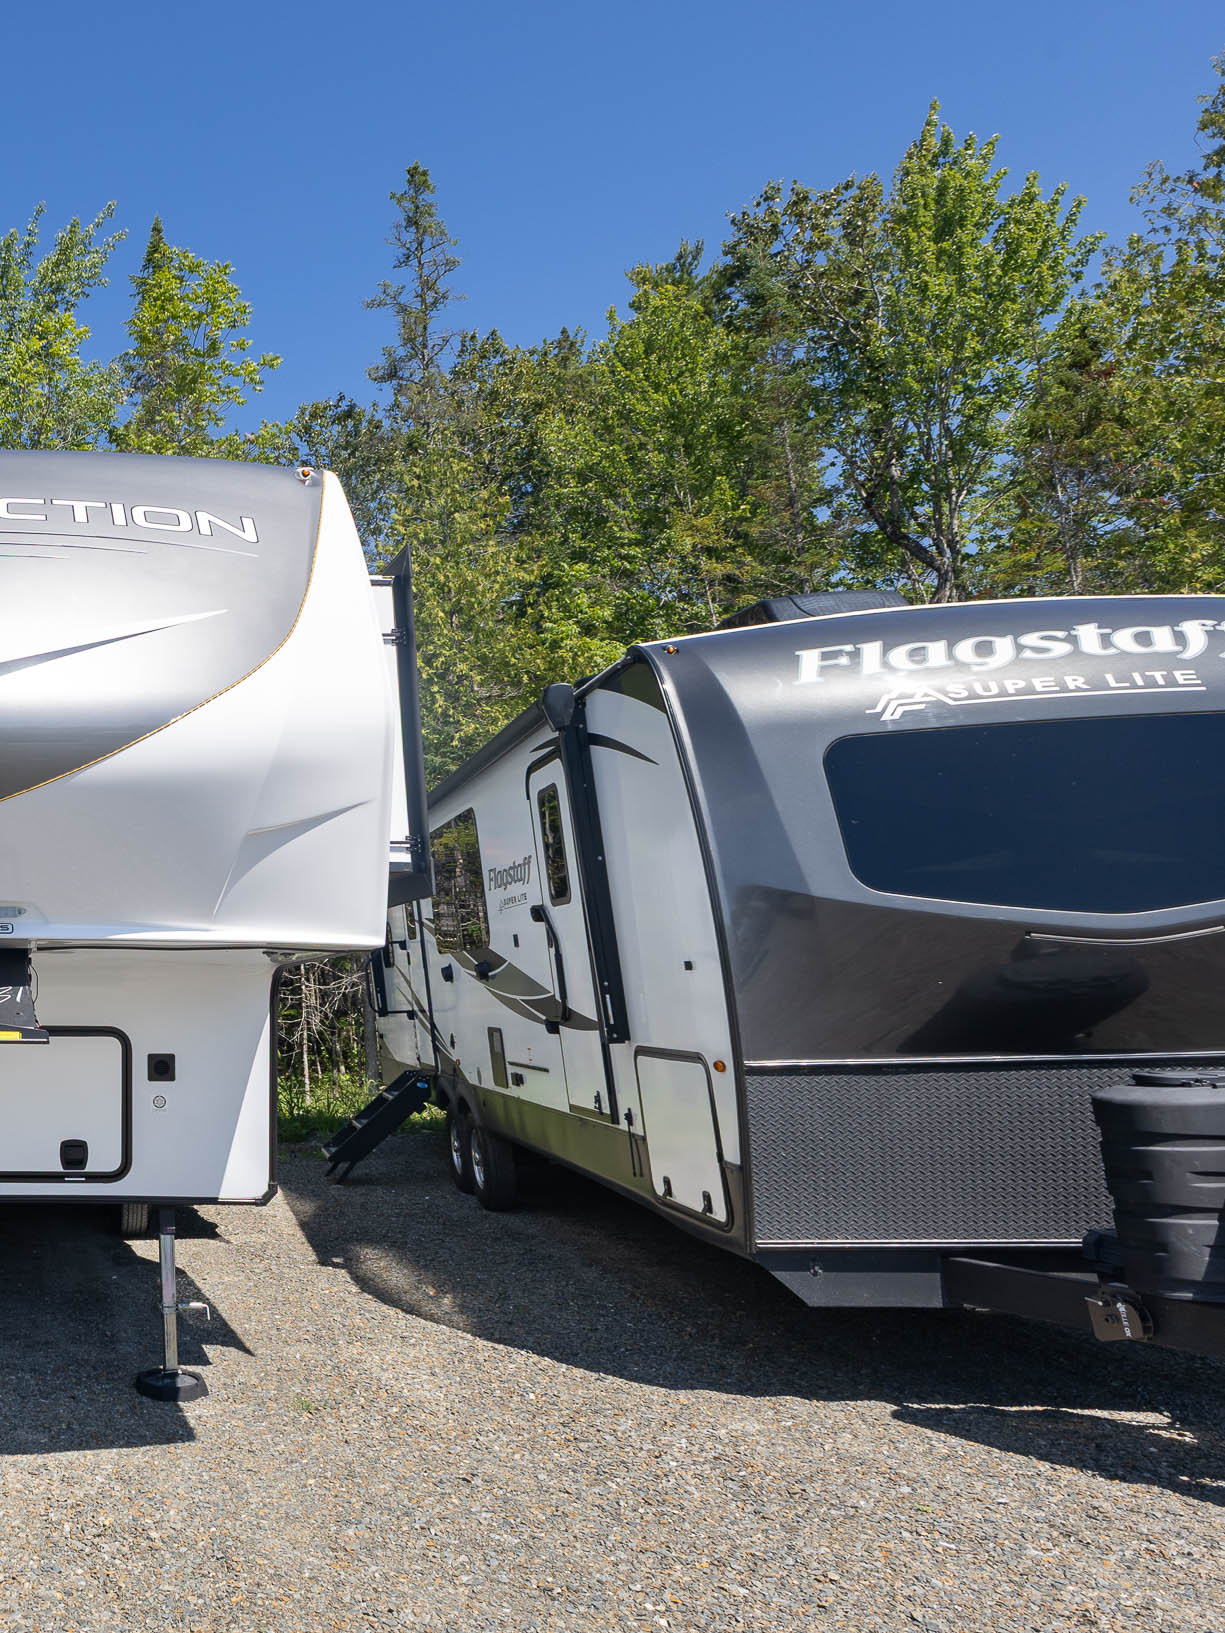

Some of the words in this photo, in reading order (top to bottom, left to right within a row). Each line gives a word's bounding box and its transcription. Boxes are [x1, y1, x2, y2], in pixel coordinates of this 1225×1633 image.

[794, 619, 1225, 685] Flagstaf
[948, 675, 1090, 699] SUPER
[1108, 669, 1203, 689] LITE
[487, 854, 533, 892] Flagstaff
